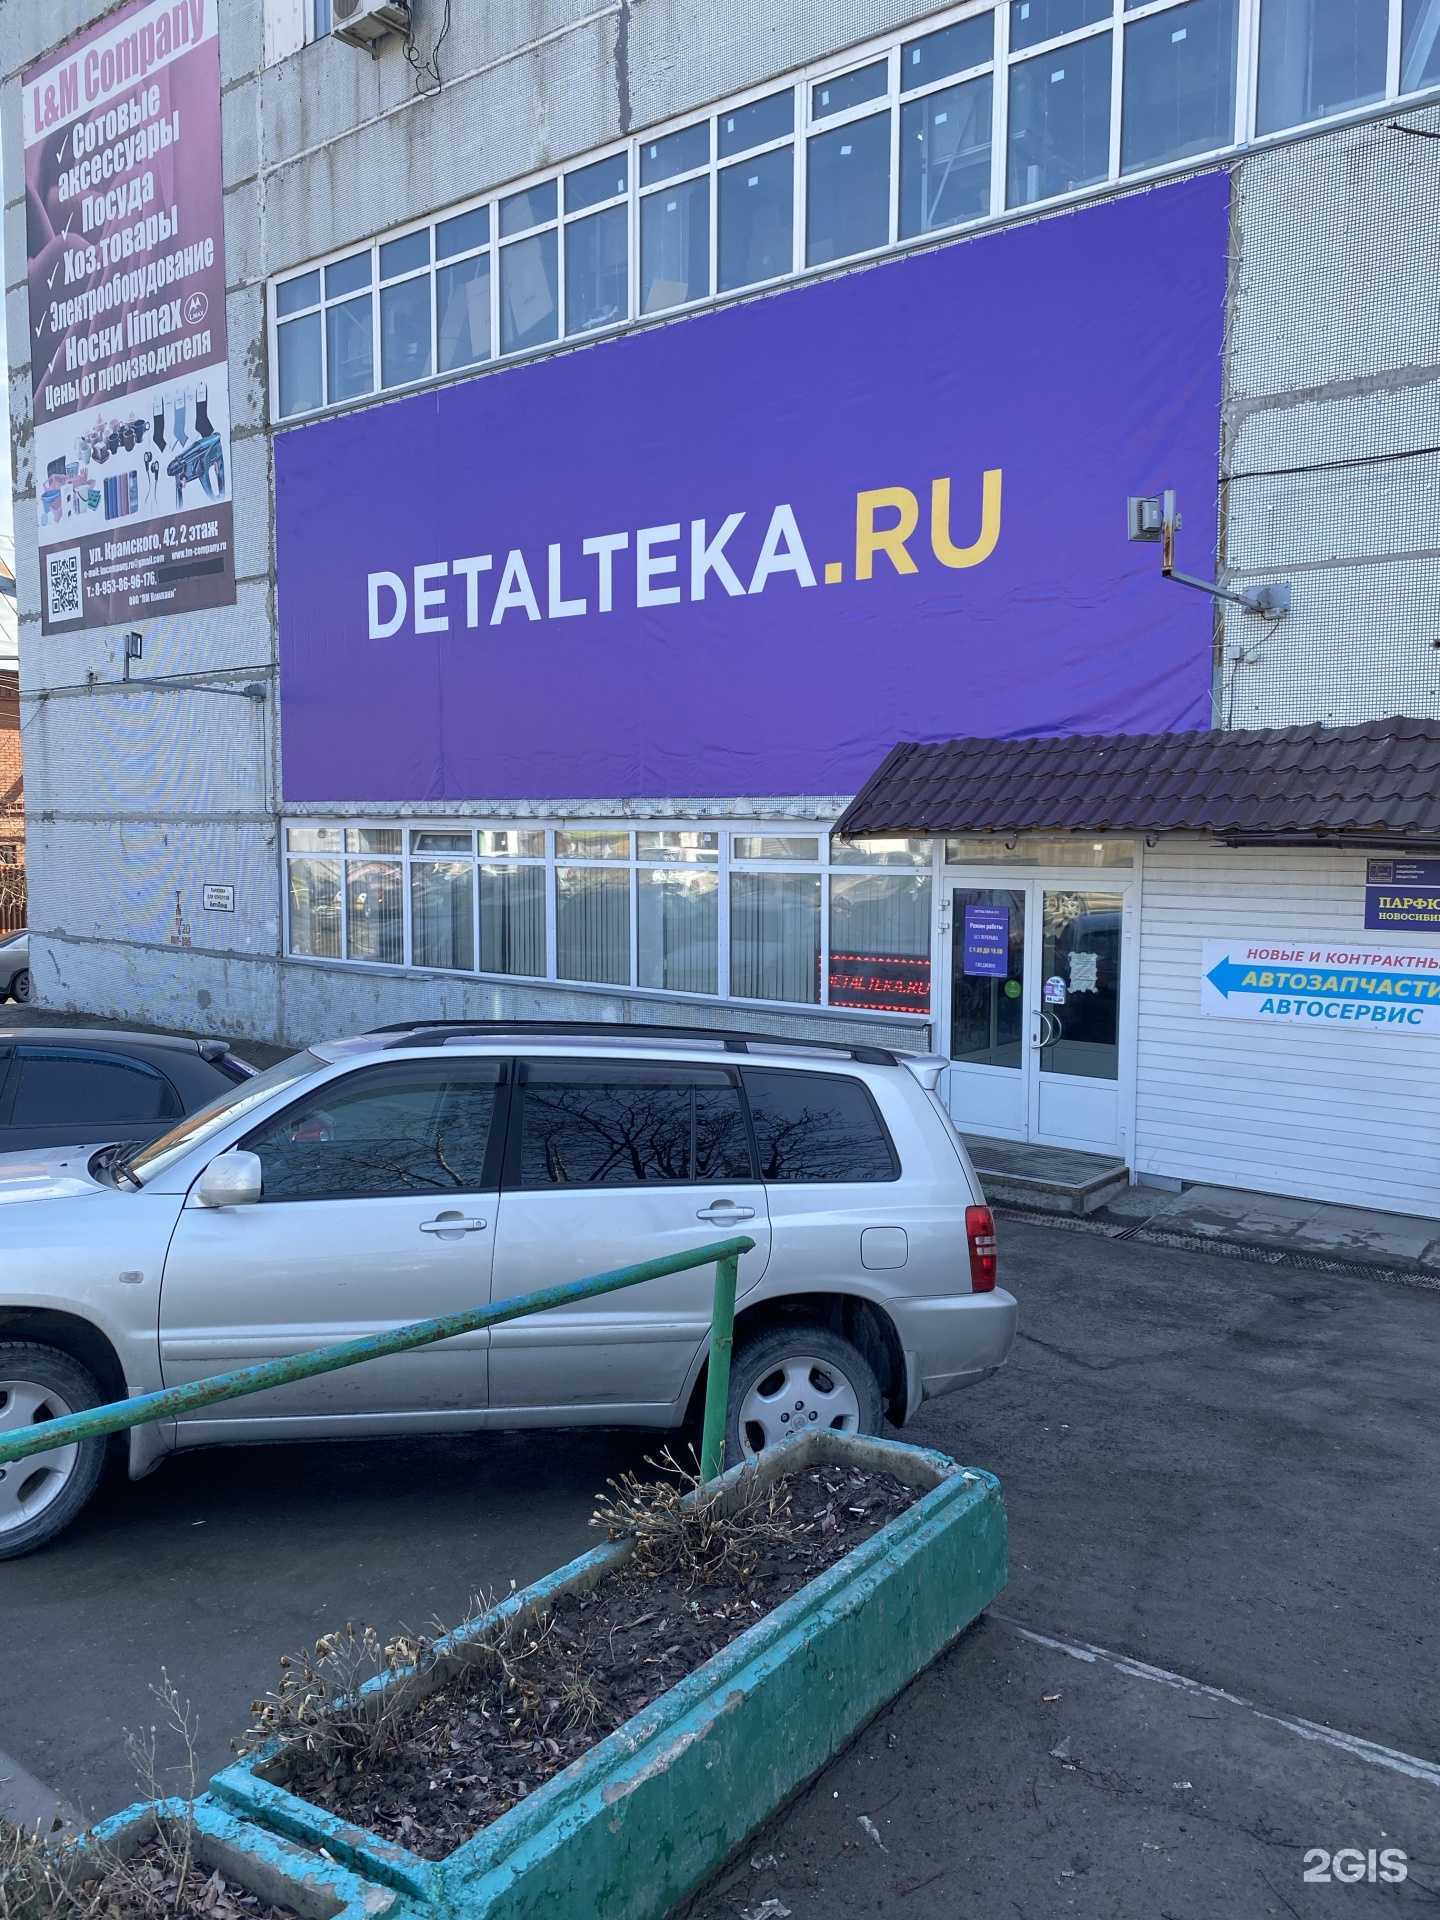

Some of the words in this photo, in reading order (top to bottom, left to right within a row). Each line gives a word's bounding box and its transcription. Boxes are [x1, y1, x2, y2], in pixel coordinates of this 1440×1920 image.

[33, 60, 79, 135] L&M
[84, 0, 205, 103] Company
[58, 110, 181, 203] аксессуары
[72, 84, 161, 160] Сотовые
[50, 237, 214, 333] Электрооборудование
[45, 379, 80, 412] Цены
[82, 370, 96, 398] от
[98, 329, 212, 392] производителя
[65, 319, 123, 372] Носки
[89, 546, 104, 565] ул.
[104, 534, 161, 560] Крамского,
[163, 527, 179, 547] 42,
[180, 524, 187, 544] 2
[189, 520, 219, 541] этаж
[367, 468, 1003, 640] DETALTEKA.RU
[1246, 948, 1305, 962] НОВЫЕ
[1308, 952, 1321, 963] И
[1259, 997, 1424, 1025] АВТОСЕРВИС
